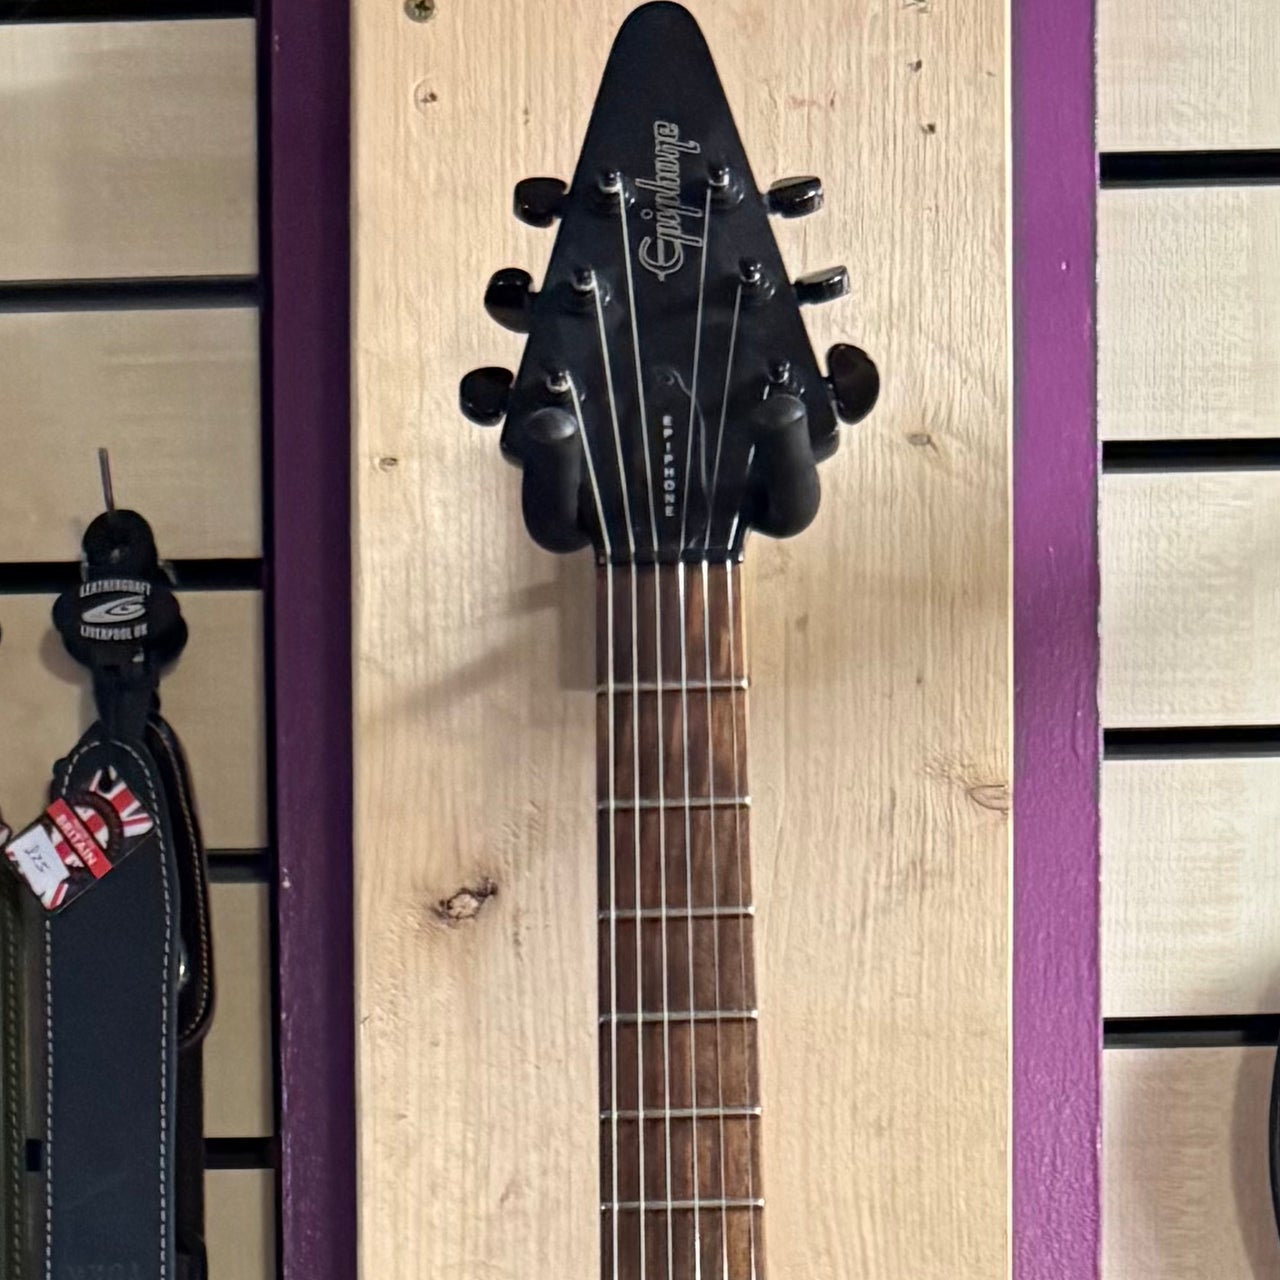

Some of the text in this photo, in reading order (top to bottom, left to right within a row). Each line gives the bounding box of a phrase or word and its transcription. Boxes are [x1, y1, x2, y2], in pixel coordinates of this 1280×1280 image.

[635, 120, 705, 281] Epiphone
[662, 414, 676, 517] EPIPHONE
[79, 579, 151, 598] LEATHERCRAFT
[80, 624, 133, 640] LIVERPOOL
[55, 812, 99, 868] BRITAIN
